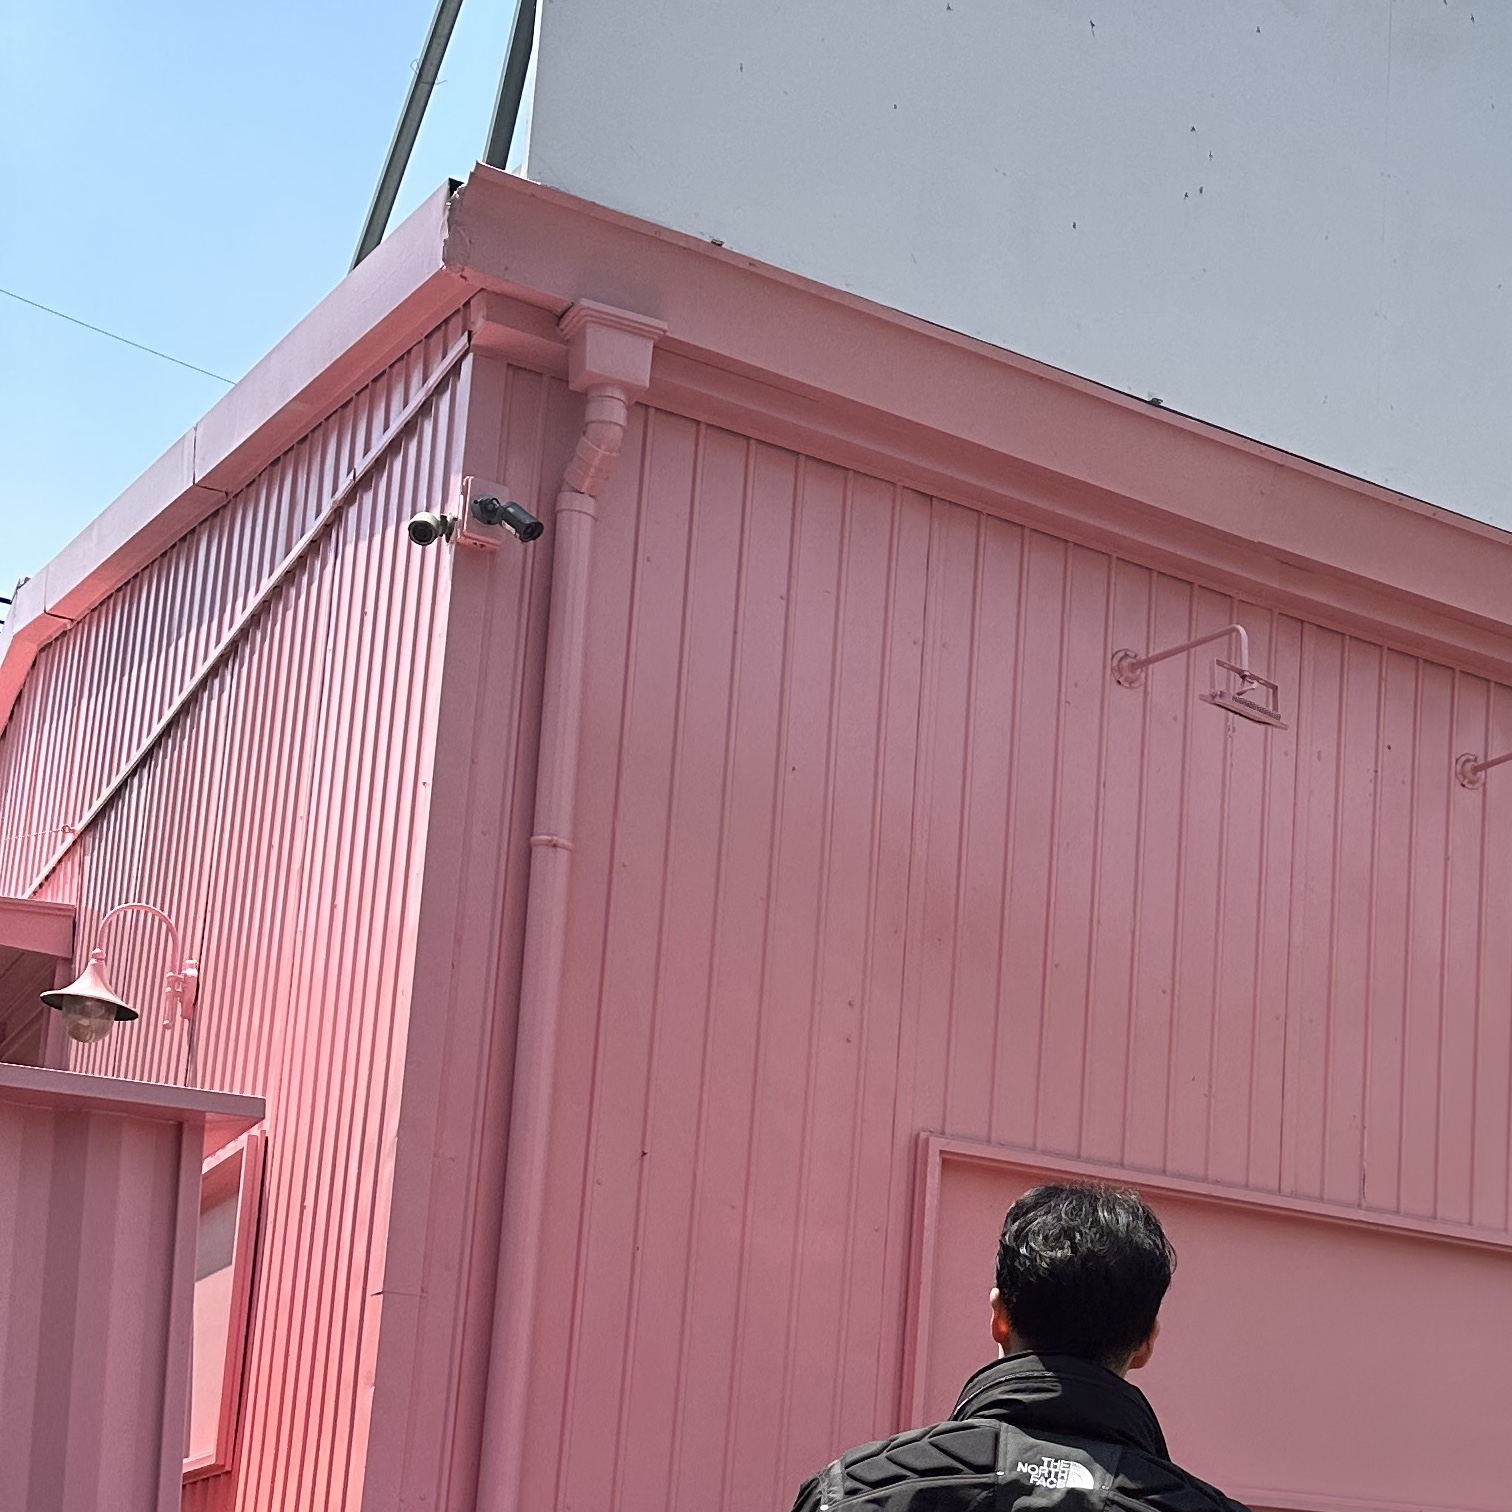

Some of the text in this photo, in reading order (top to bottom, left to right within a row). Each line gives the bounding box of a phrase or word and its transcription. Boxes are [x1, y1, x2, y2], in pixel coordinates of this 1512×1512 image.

[1041, 1457, 1070, 1471] THE
[1017, 1462, 1068, 1482] NORTH
[1030, 1474, 1067, 1489] FACE
